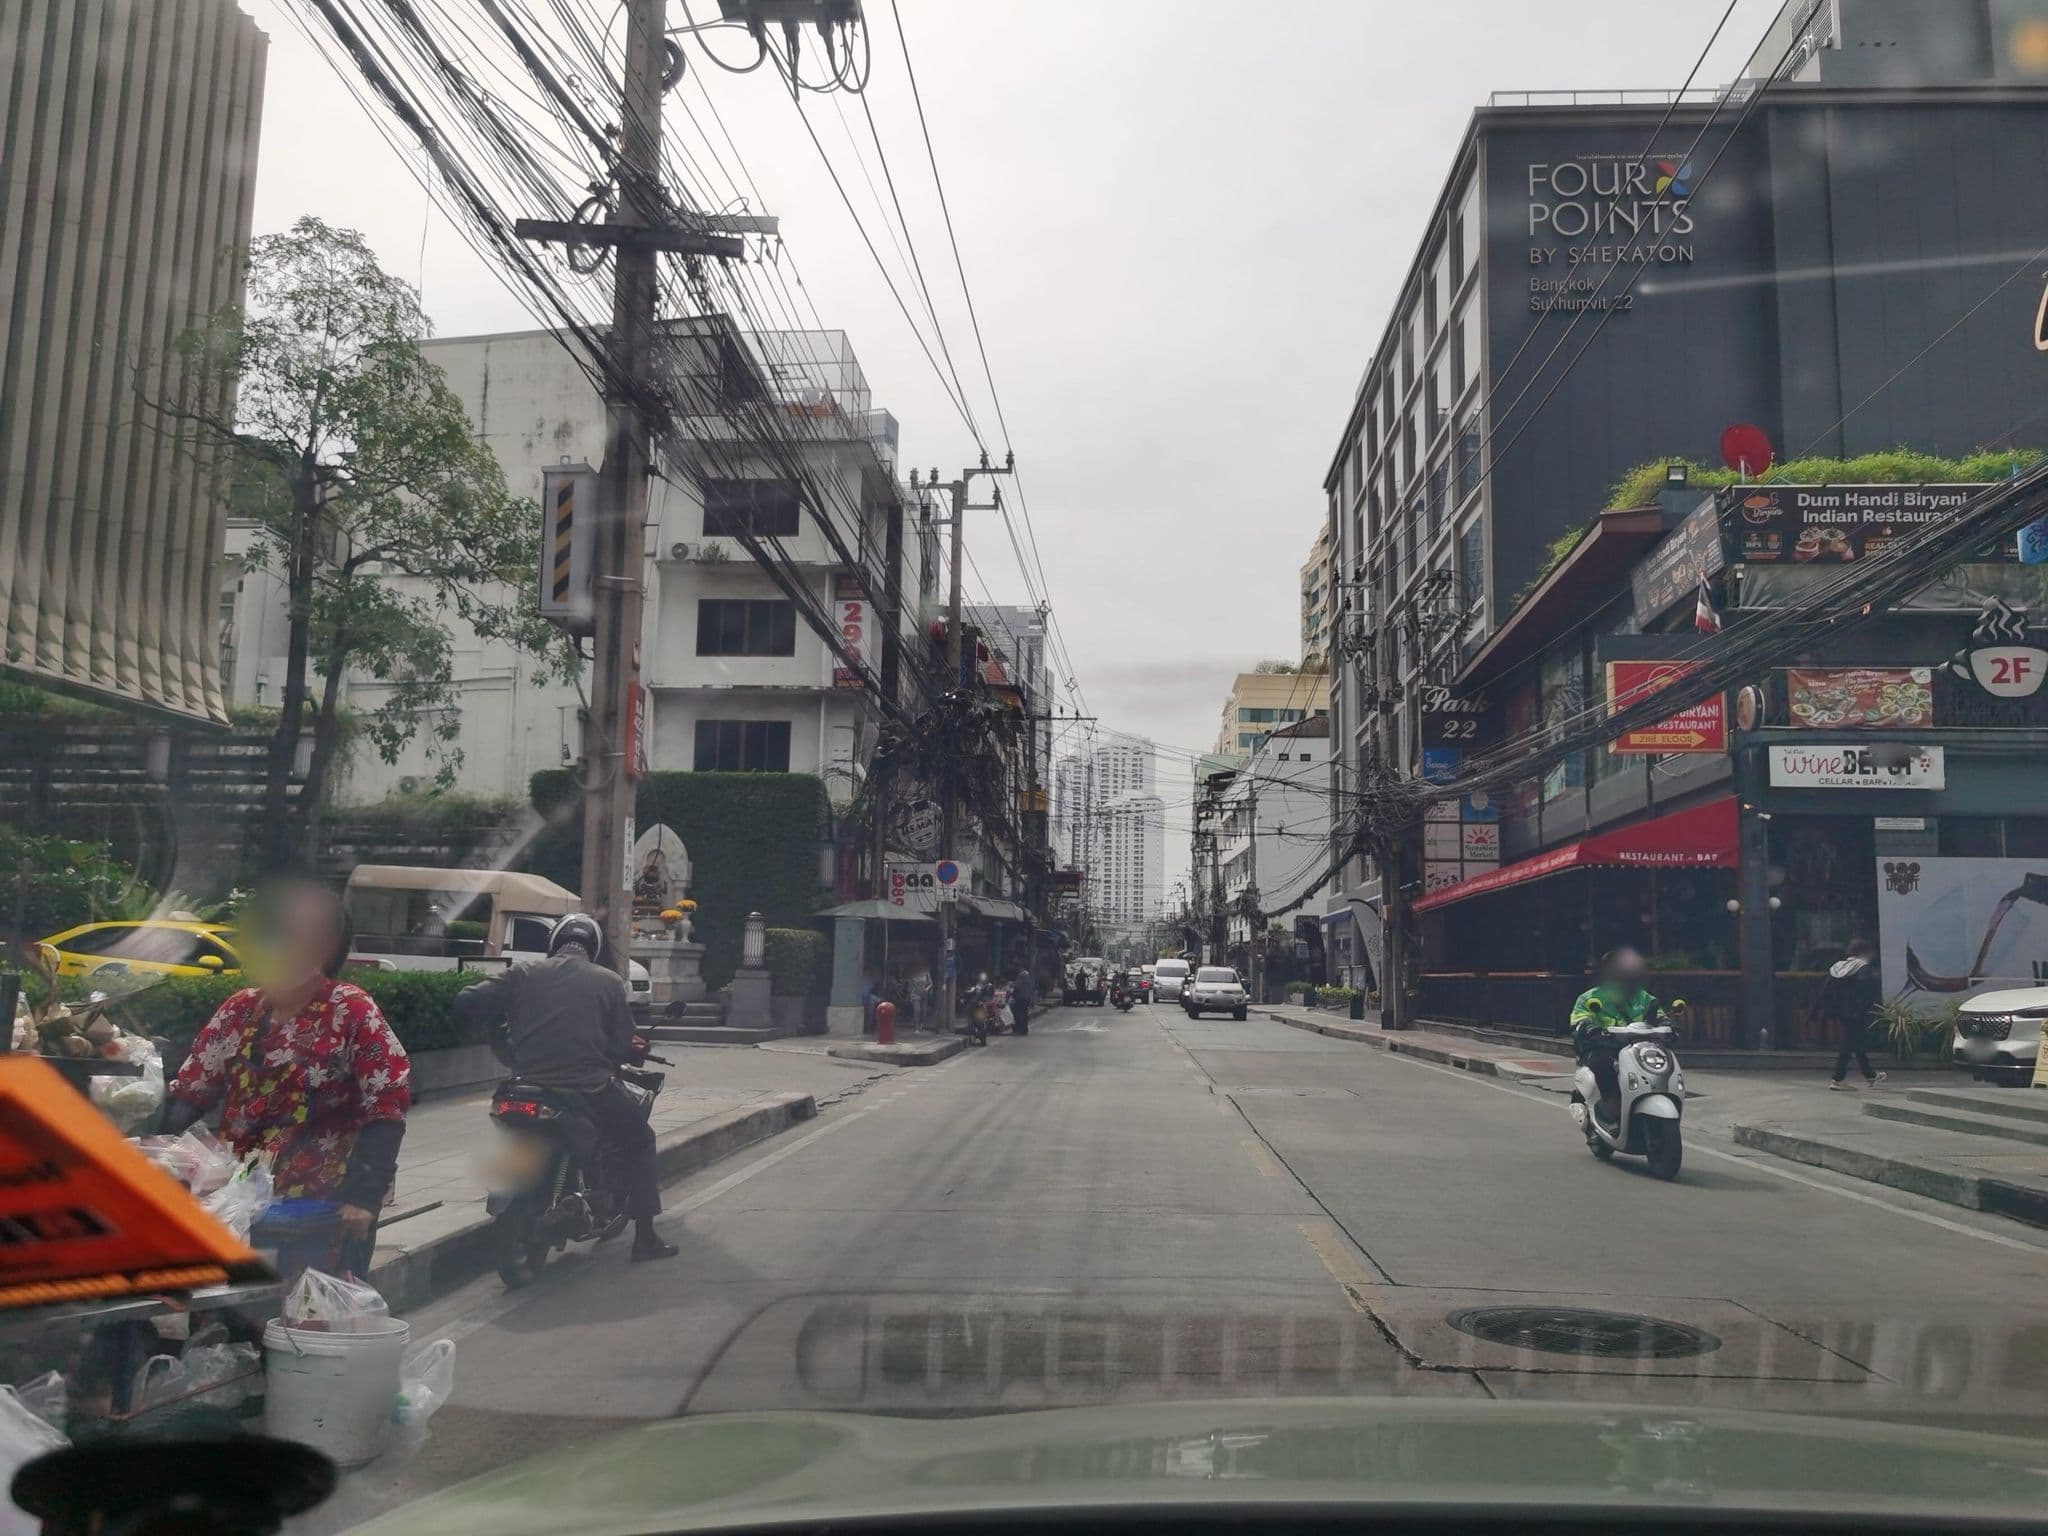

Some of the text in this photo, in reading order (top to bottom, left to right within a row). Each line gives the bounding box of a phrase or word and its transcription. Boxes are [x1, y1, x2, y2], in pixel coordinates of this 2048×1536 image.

[1528, 162, 1652, 198] FOUR
[1528, 199, 1695, 236] POINTS
[1529, 244, 1695, 265] BY SHERATON
[1529, 276, 1596, 294] Bangkok
[1529, 295, 1633, 311] Sukhumvit 22
[1796, 491, 1967, 510] Dum Handi Biryani
[1802, 509, 1859, 524] Indian
[1989, 656, 2031, 685] 2F
[1421, 686, 1489, 714] Park
[1441, 719, 1476, 739] 22
[1783, 754, 1845, 775] wine
[1818, 777, 1854, 786] CELLAR
[1619, 852, 1685, 862] RESTAURANT
